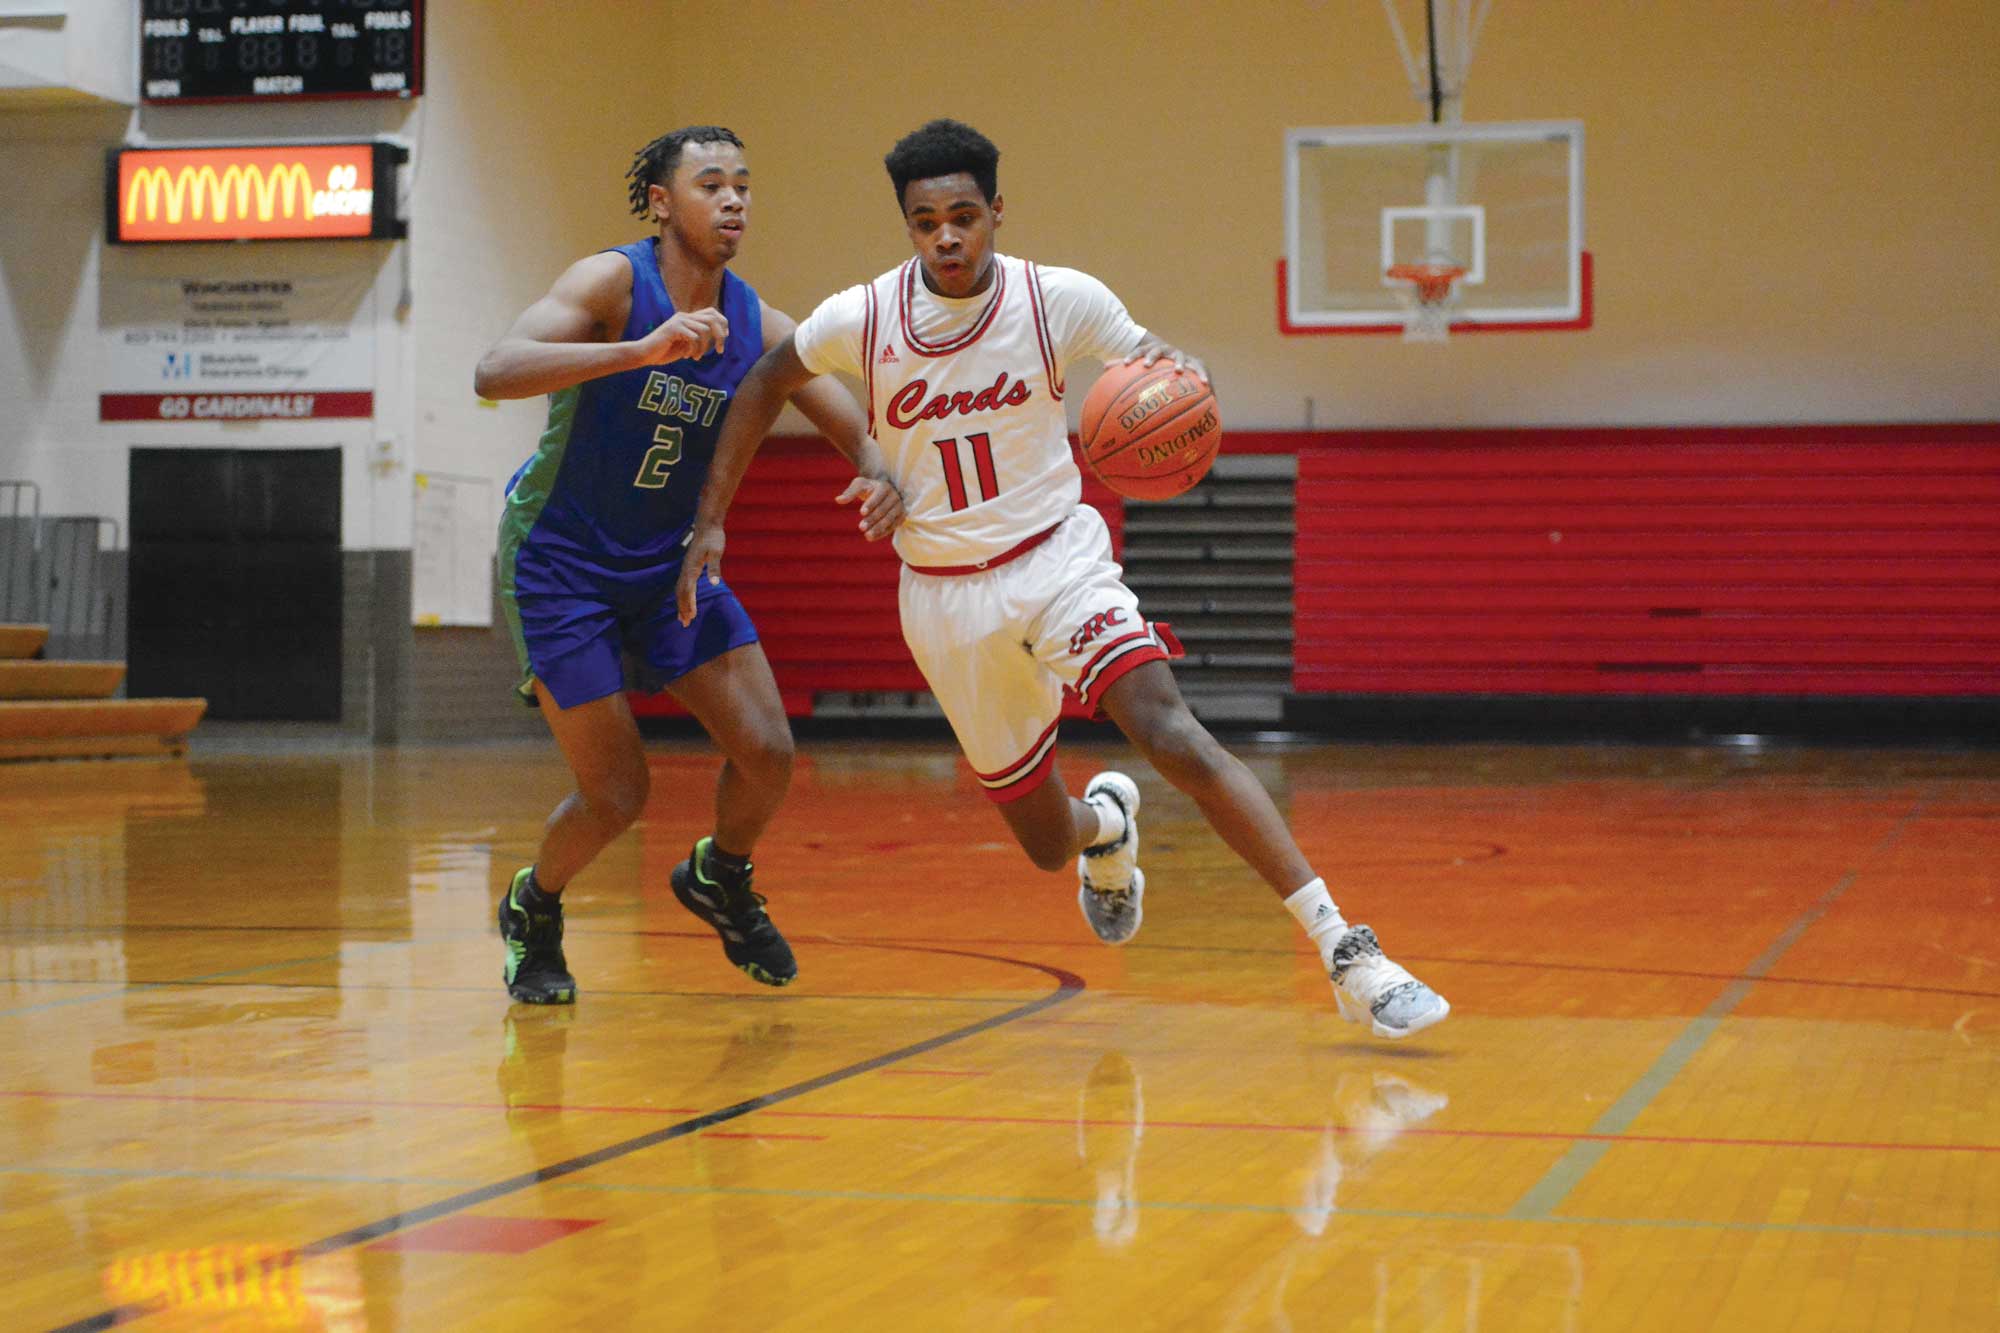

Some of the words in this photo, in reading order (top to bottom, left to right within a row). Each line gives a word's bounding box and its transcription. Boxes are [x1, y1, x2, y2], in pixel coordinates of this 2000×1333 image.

[145, 19, 190, 37] FOULS
[230, 16, 284, 34] PLAYER
[288, 14, 325, 32] FOUL
[364, 11, 411, 30] FOULS
[159, 396, 190, 418] GO
[193, 395, 315, 418] CARDINALS!
[638, 370, 727, 427] EAST
[887, 371, 1032, 429] Cards
[633, 424, 683, 489] 2
[1137, 405, 1218, 468] SPALDING
[932, 432, 999, 512] 11
